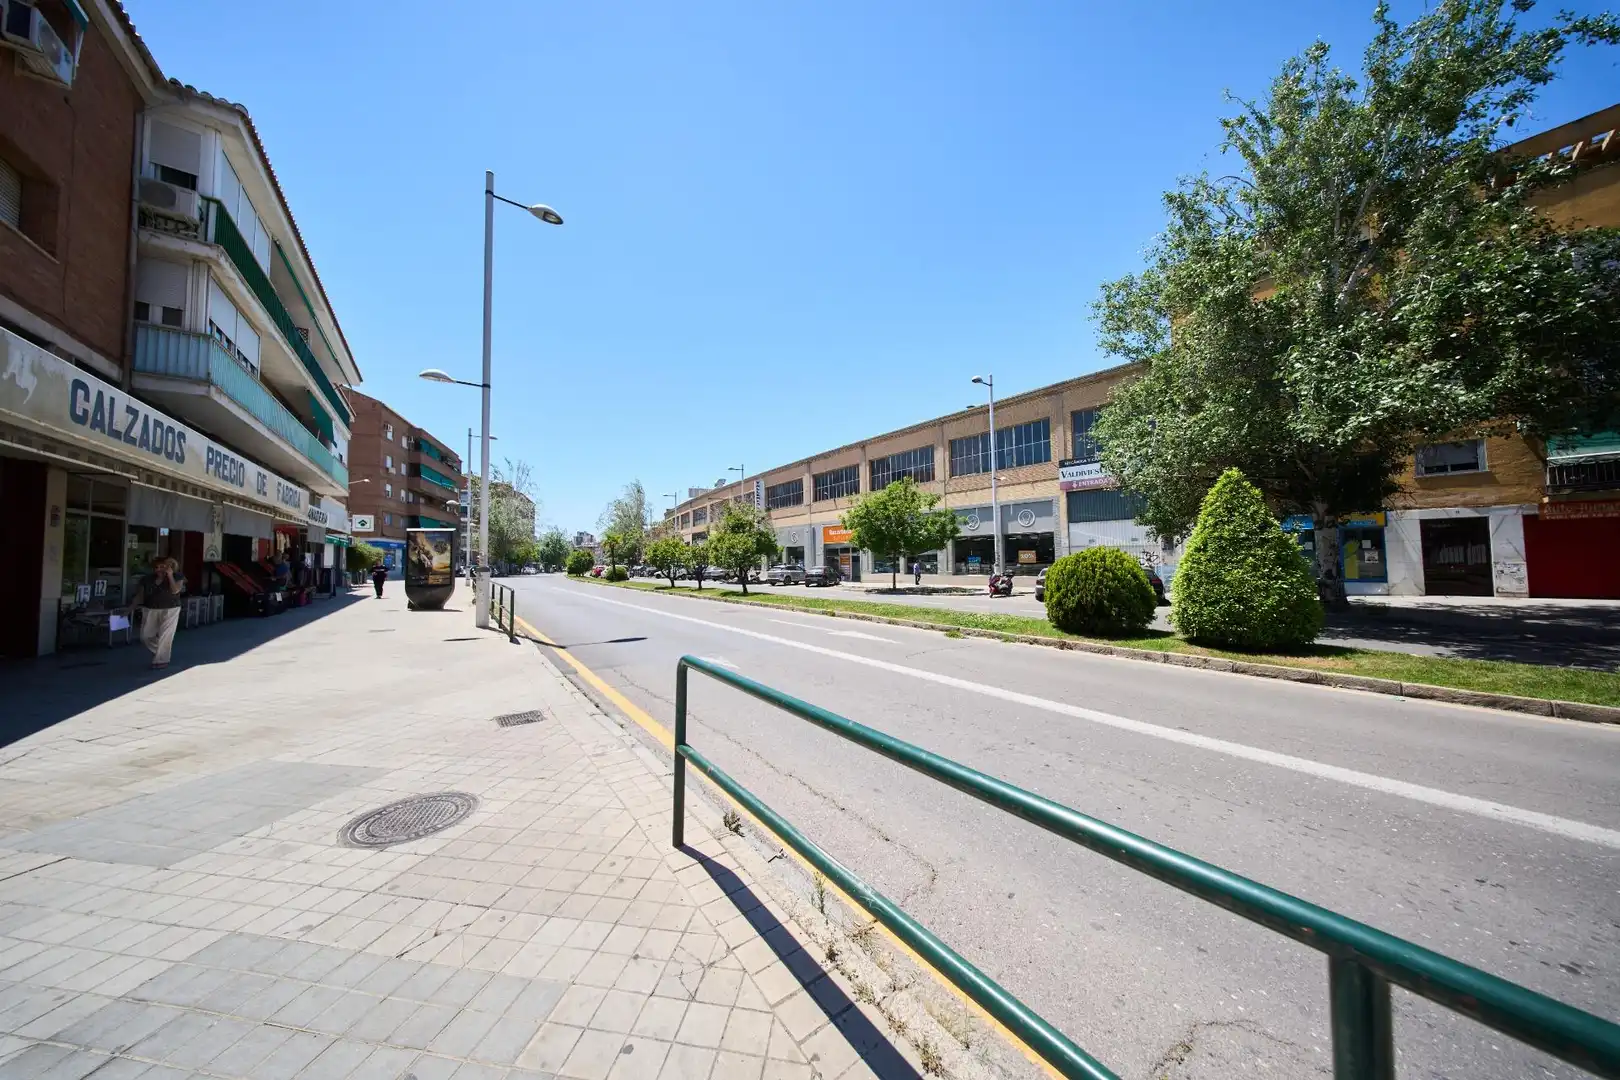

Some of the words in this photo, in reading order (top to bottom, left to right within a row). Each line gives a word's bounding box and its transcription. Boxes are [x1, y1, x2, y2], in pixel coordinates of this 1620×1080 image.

[70, 378, 186, 464] CALZADOS
[206, 445, 245, 488] PRECIO
[256, 471, 268, 497] DE
